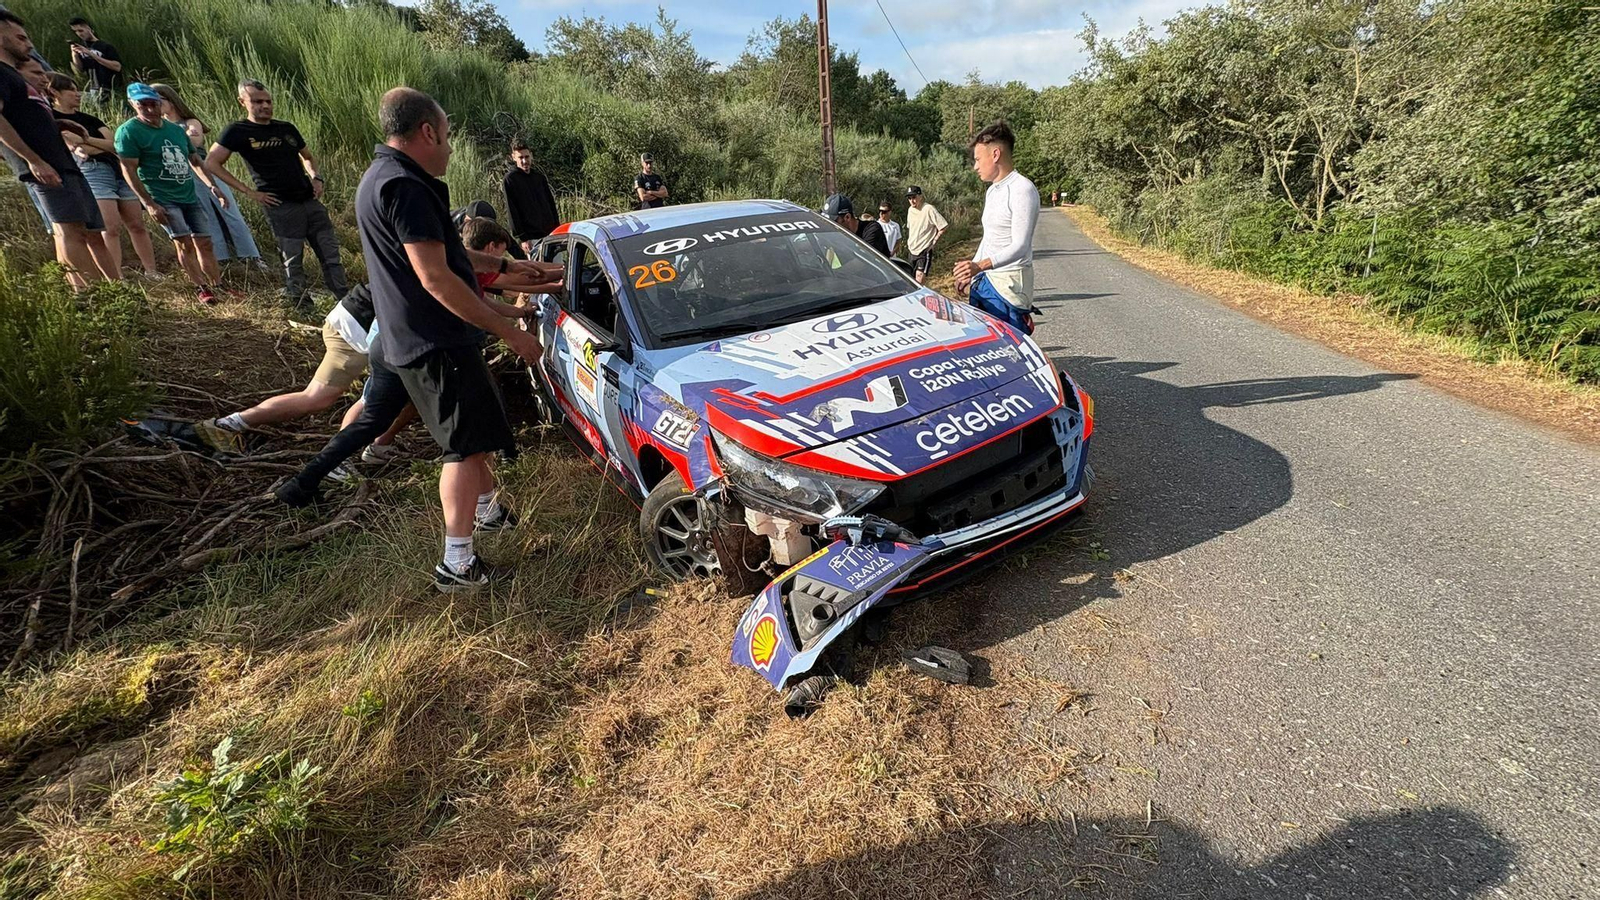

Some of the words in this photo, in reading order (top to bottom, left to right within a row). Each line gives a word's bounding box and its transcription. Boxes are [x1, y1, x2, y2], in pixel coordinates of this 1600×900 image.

[702, 220, 820, 243] HYUNDAI
[628, 259, 677, 289] 26
[792, 316, 932, 360] HYUNDAI
[846, 332, 927, 362] Asturdai
[908, 360, 956, 379] Copa
[920, 371, 965, 392] i20N
[960, 364, 1007, 380] Rallye
[916, 394, 1034, 459] cetelem
[846, 556, 890, 585] PRAVIA
